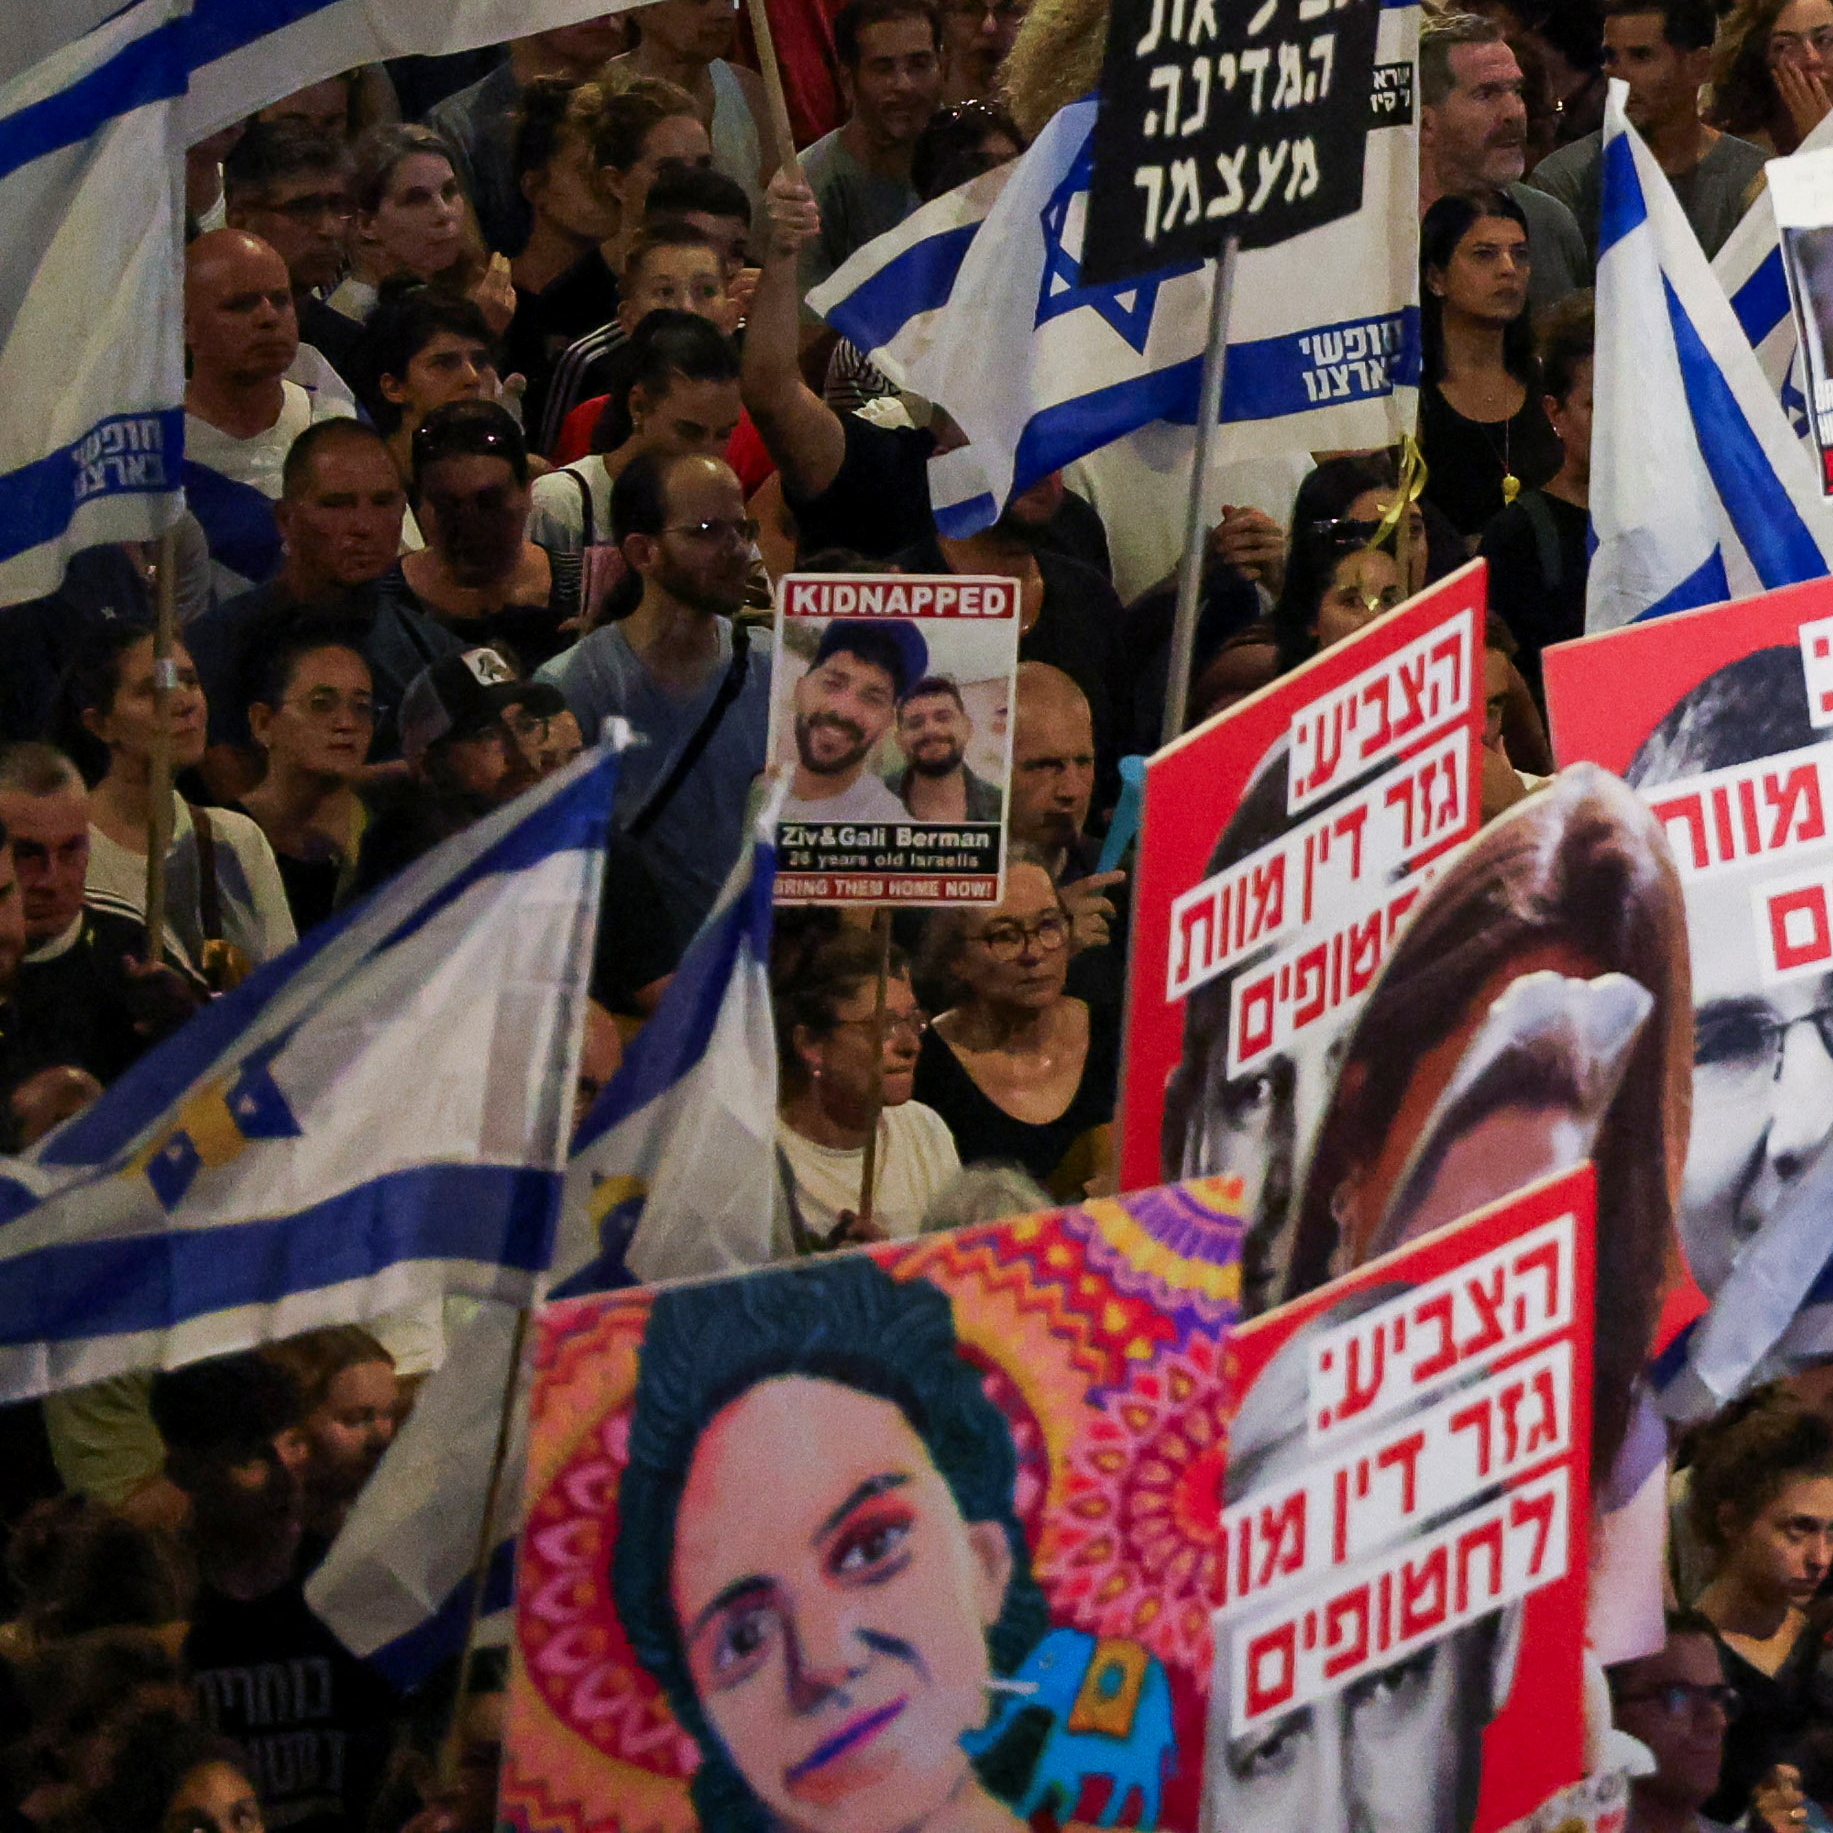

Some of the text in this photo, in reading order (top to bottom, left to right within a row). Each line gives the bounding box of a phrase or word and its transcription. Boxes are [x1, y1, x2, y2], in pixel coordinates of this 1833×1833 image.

[1143, 33, 1336, 138] המדינה
[1133, 136, 1319, 243] מעצמך
[791, 583, 1007, 616] KIDNAPPED
[1294, 628, 1463, 799] הצביע:
[781, 825, 991, 850] Ziv&Gali Berman
[874, 852, 905, 868] old
[1175, 750, 1459, 985] גזר דין מוות
[1318, 1239, 1560, 1431] הצביע:
[1450, 1367, 1558, 1477] גזר
[1333, 1430, 1427, 1566] דין
[1245, 1491, 1556, 1721] לחטופים
